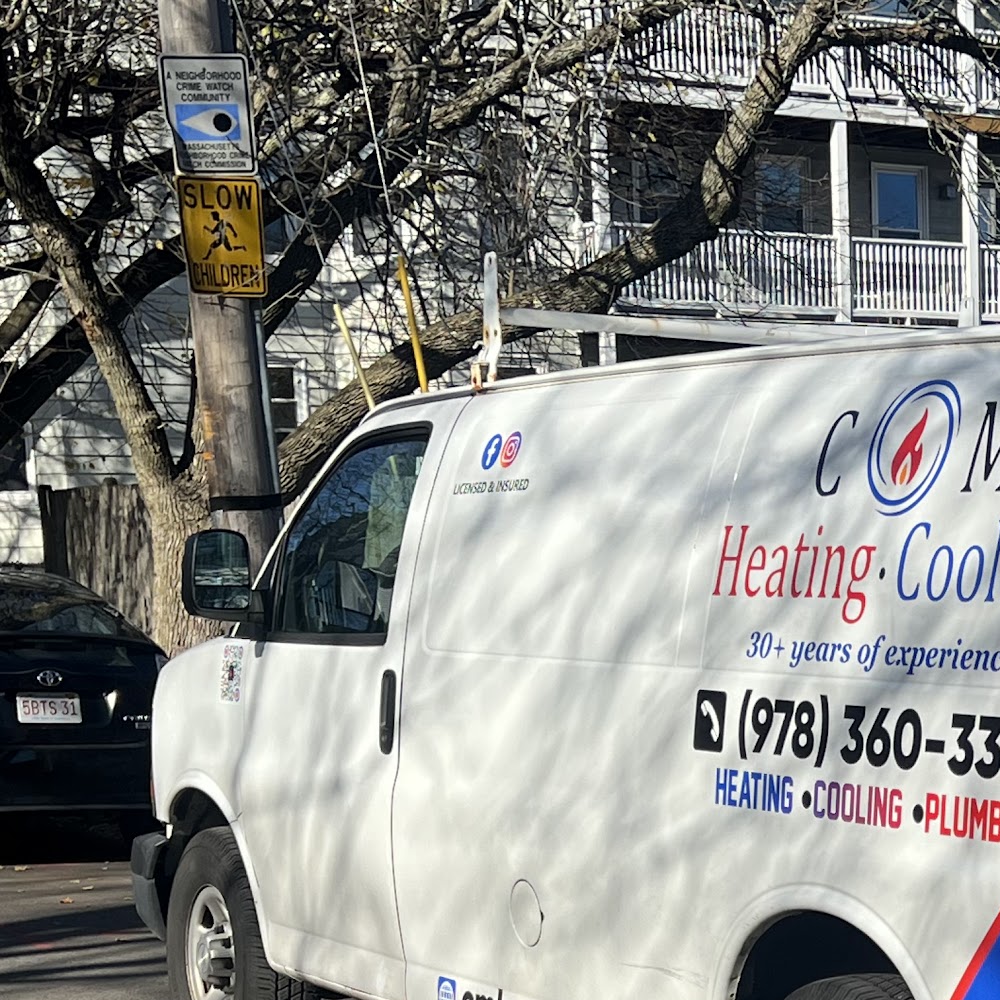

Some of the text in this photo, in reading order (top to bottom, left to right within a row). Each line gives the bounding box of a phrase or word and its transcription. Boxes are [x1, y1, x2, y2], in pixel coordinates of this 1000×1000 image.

[166, 71, 242, 81] A NEIGHBORHOOD
[176, 82, 234, 91] CRIME WATCH
[181, 93, 231, 102] COMMUNITY
[183, 183, 253, 210] SLOW
[191, 262, 260, 288] CHILDREN
[815, 409, 859, 497] C
[453, 478, 530, 496] LICENSED & INSURED
[712, 524, 876, 624] Heating
[746, 631, 785, 659] 30+
[789, 638, 852, 668] years
[857, 635, 886, 672] of
[22, 700, 77, 716] 5BTS 31
[738, 688, 830, 768] (978)
[715, 767, 794, 815] HEATING
